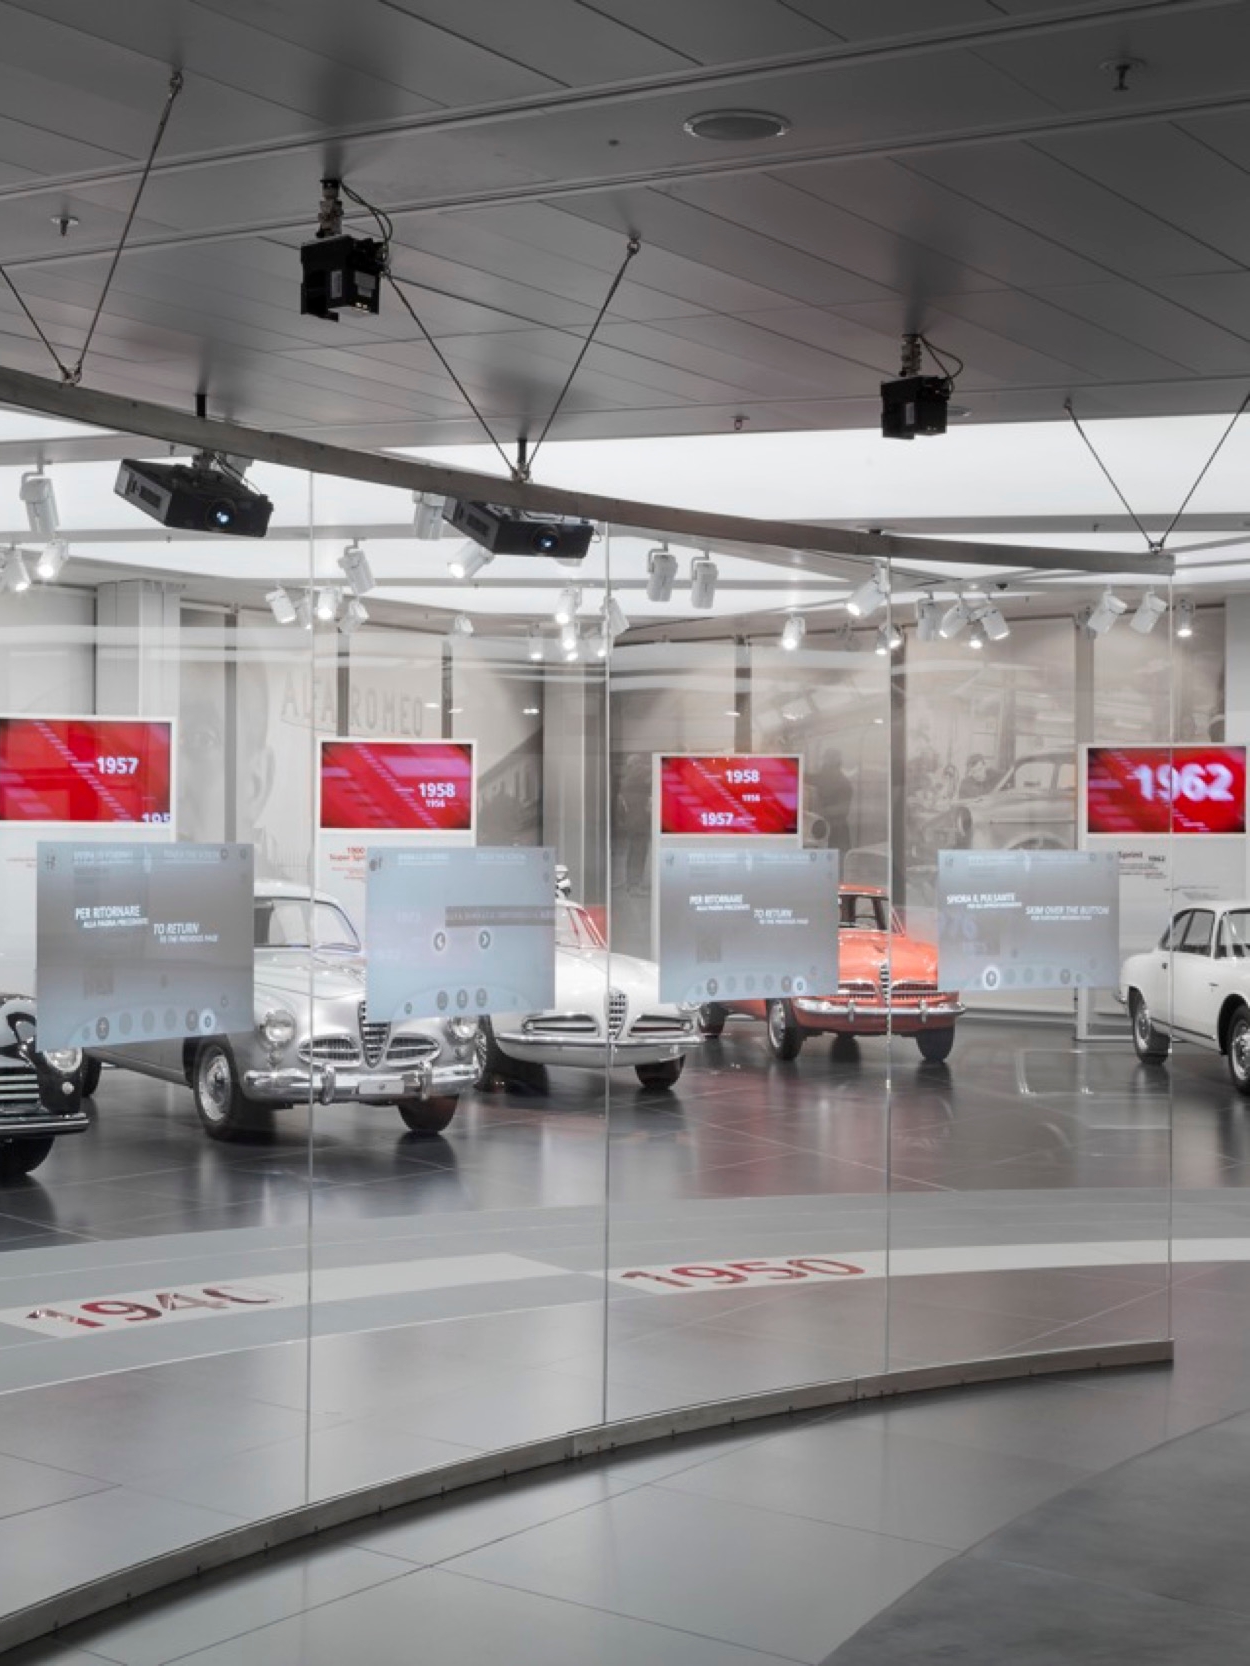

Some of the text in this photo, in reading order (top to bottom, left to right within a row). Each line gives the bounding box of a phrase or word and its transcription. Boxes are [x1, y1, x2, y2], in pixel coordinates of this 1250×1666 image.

[349, 686, 423, 737] ROMEO
[96, 756, 139, 775] 1957
[725, 769, 760, 784] 1958
[1134, 763, 1235, 802] 1962
[418, 783, 456, 798] 1958
[700, 812, 734, 826] 1957
[75, 904, 142, 920] PER RITORNARE
[153, 922, 200, 936] TO RETURN
[620, 1258, 866, 1288] 1950
